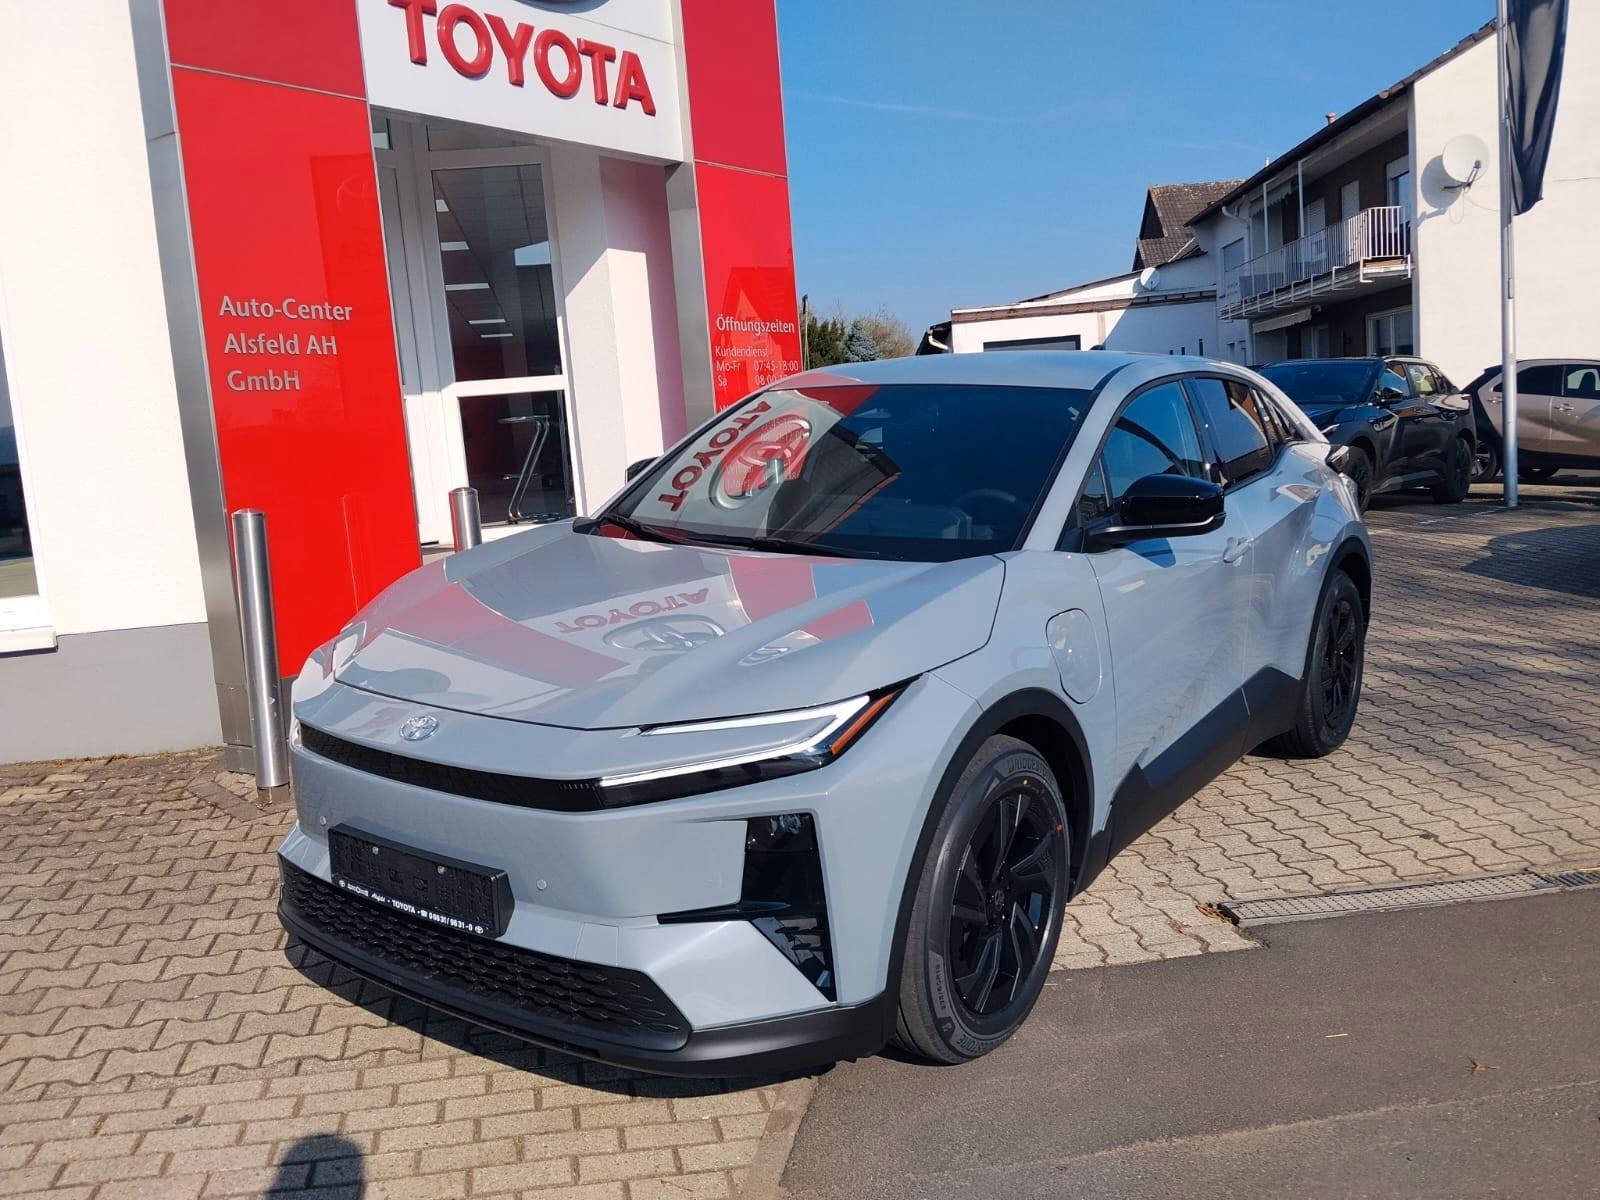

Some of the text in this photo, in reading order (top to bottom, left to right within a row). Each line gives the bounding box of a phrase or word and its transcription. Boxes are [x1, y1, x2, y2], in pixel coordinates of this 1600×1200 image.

[387, 0, 656, 117] TOYOTA
[219, 295, 352, 320] Auto-Center
[716, 313, 795, 336] Öffnungszeiten
[224, 332, 338, 355] Alsfeld AH
[715, 345, 768, 357] Kundendienst
[716, 360, 741, 371] Mo-Fr
[227, 368, 300, 392] GmbH
[717, 375, 728, 386] Sa
[391, 899, 416, 914] TOYOTA
